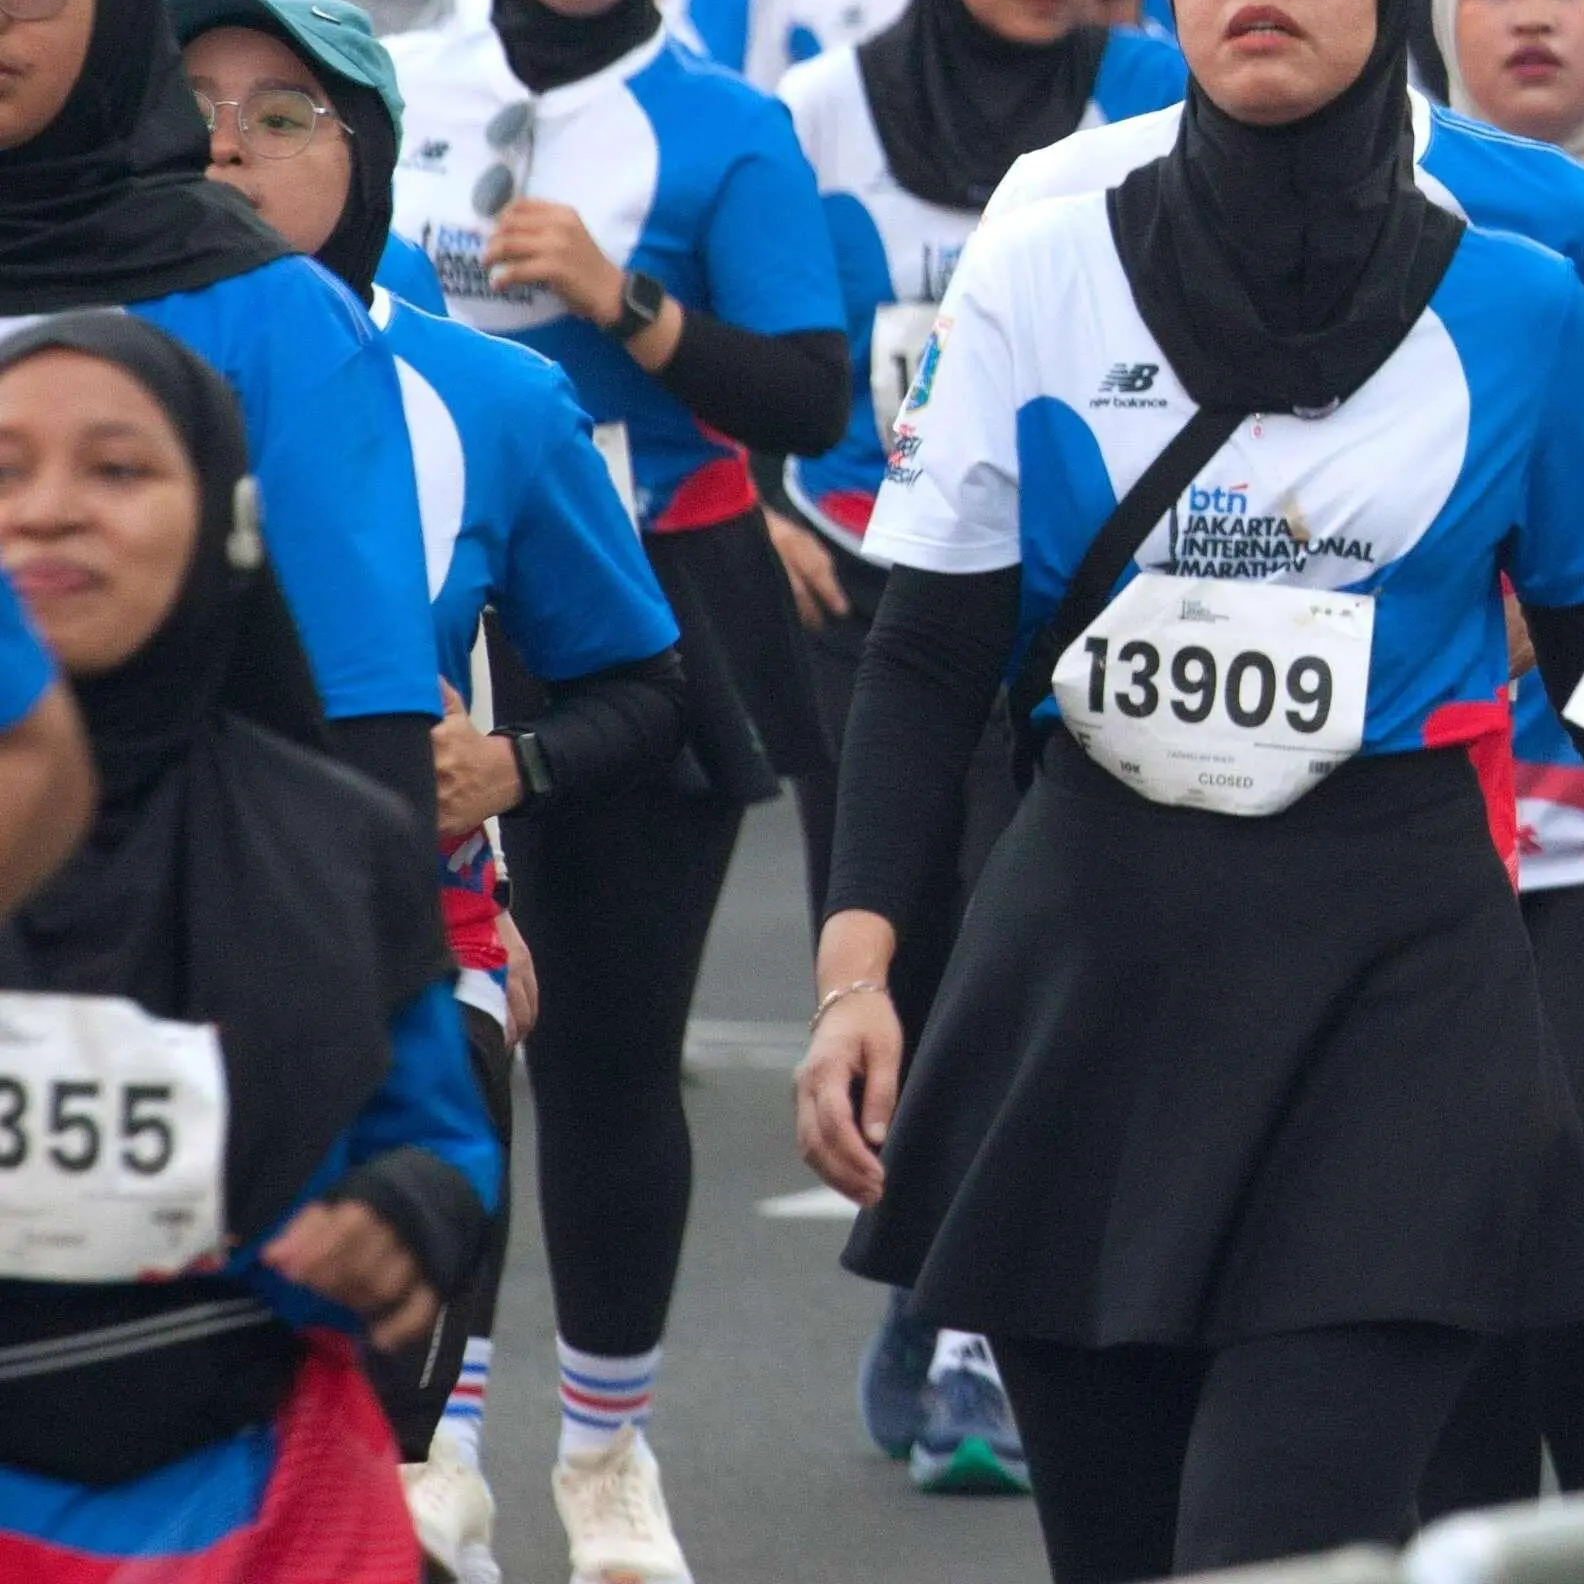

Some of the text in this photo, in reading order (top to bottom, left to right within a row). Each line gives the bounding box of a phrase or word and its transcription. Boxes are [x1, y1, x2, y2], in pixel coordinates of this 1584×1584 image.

[1089, 397, 1168, 409] new balance
[1189, 483, 1249, 514] btn
[1184, 516, 1293, 538] JAKARTA
[1085, 636, 1333, 733] 13909
[1198, 772, 1254, 789] CLOSED
